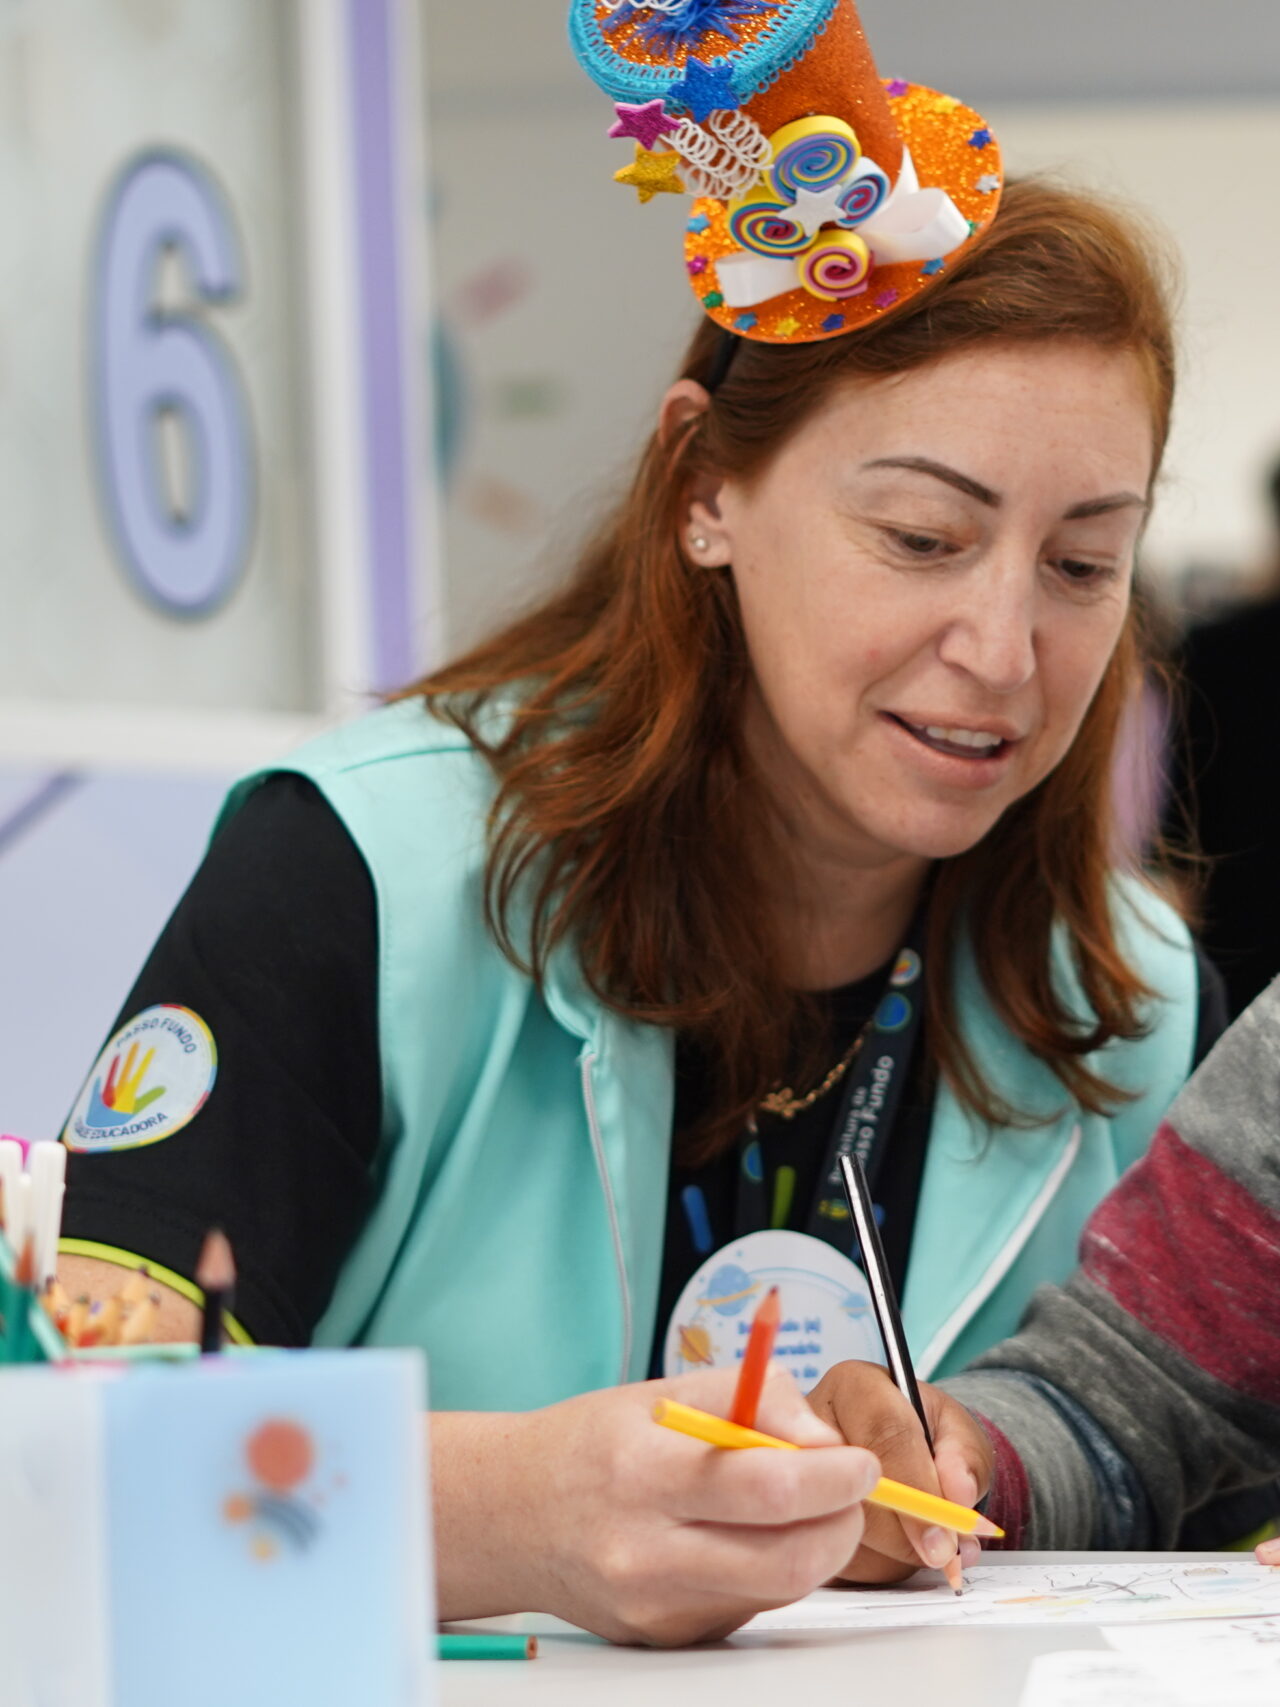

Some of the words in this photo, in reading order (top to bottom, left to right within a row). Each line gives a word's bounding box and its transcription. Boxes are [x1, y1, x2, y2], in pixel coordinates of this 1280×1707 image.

[93, 144, 259, 622] 6
[160, 1017, 197, 1054] FUNDO
[859, 1055, 895, 1123] Fundo
